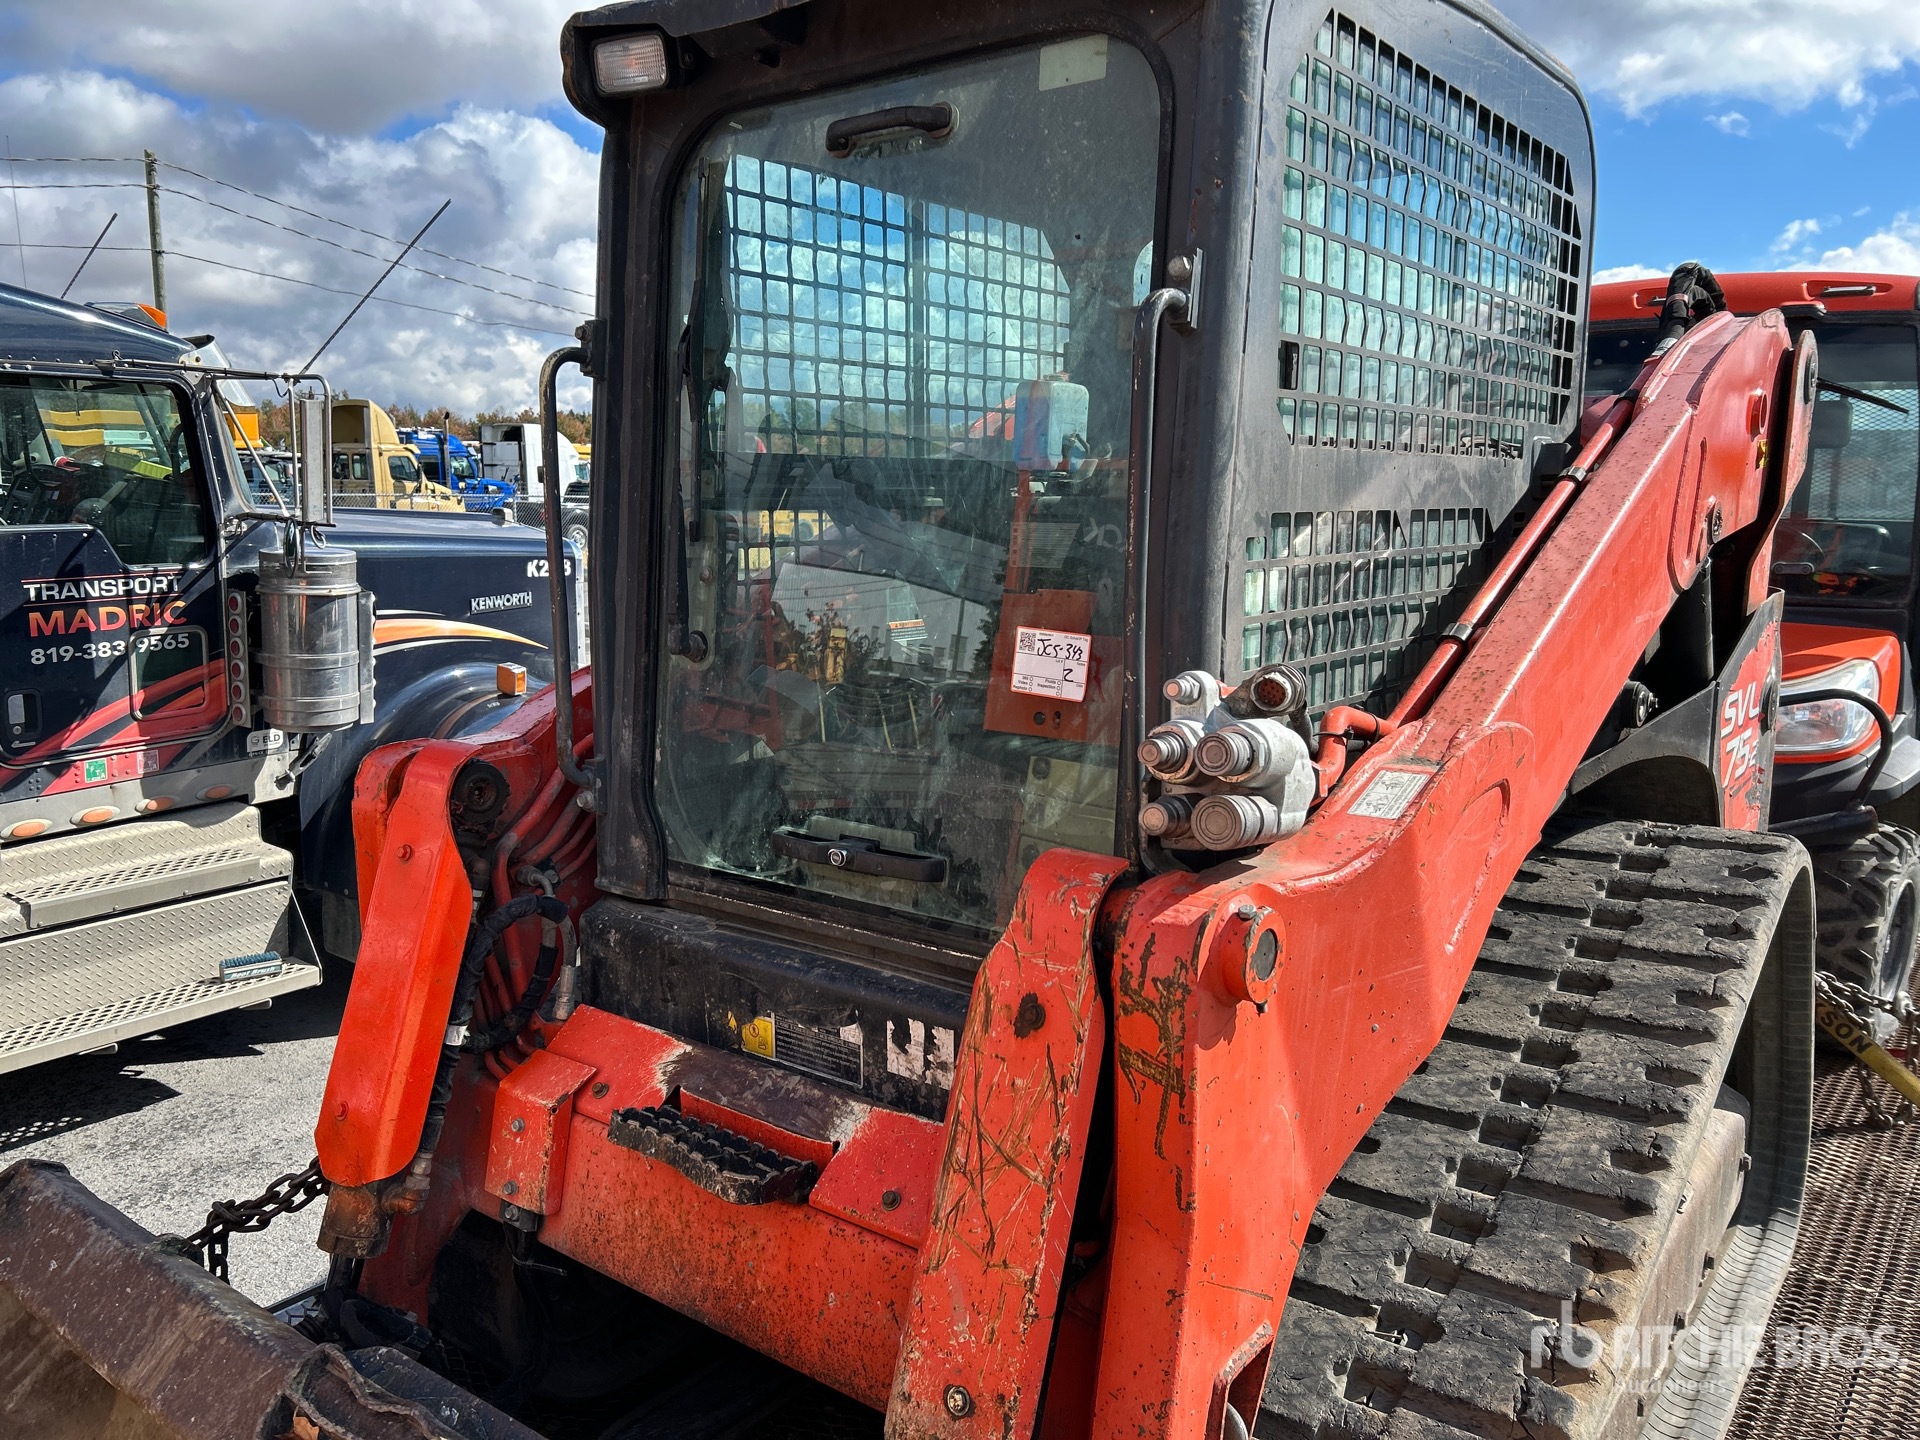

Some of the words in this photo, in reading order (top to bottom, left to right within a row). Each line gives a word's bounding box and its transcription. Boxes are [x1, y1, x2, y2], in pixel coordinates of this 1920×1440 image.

[23, 575, 181, 602] TRANSPORT
[470, 591, 532, 611] KENWORTH
[28, 601, 187, 637] MADRIC
[1720, 681, 1759, 738] SVL
